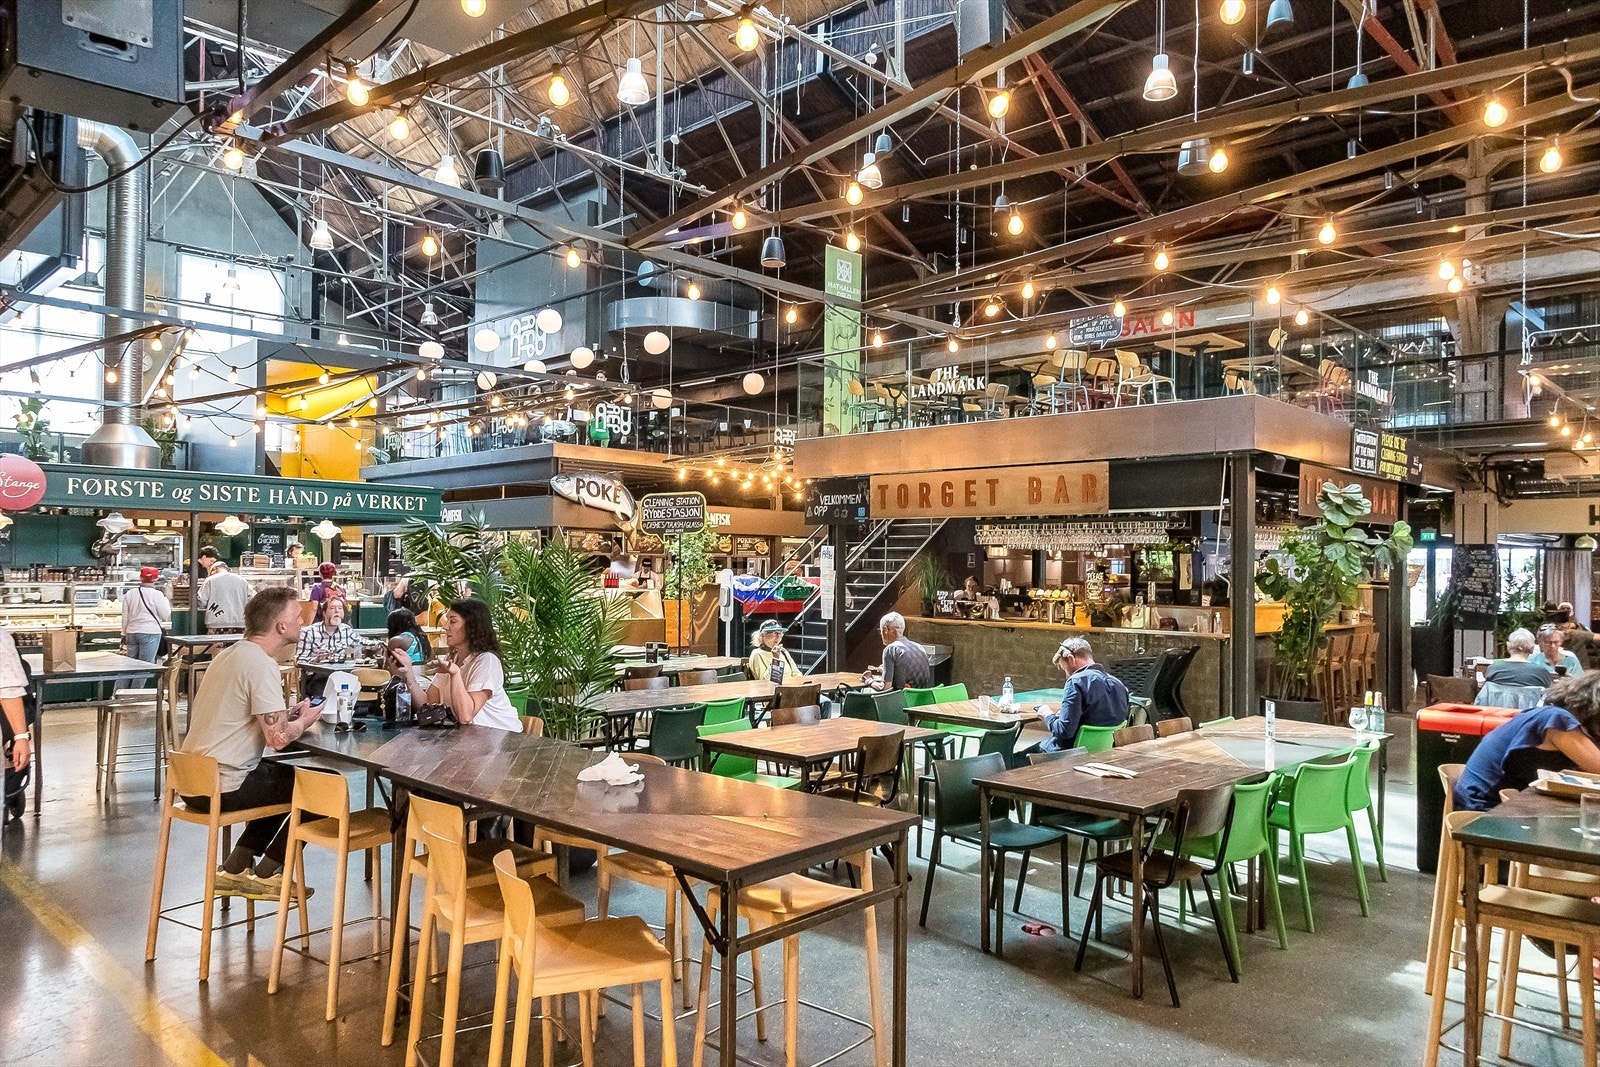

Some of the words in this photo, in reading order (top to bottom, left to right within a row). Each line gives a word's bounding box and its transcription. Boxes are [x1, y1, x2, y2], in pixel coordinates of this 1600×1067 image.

[936, 365, 960, 381] THE
[1367, 369, 1379, 385] THE
[911, 376, 986, 398] LANDMARK
[1357, 380, 1389, 404] LANDMARK
[67, 477, 165, 498] FØRSTE
[171, 486, 193, 503] og
[199, 484, 261, 503] SISTE
[269, 485, 329, 506] HÅND
[332, 492, 352, 510] på
[356, 493, 428, 512] VERKET
[575, 477, 622, 505] POKE
[877, 478, 1000, 510] TORGET
[1028, 473, 1099, 504] BAR
[643, 497, 675, 508] CLEANING
[675, 496, 701, 505] STATION
[819, 493, 862, 506] VELKOMMEN
[1372, 486, 1397, 516] BAR
[643, 507, 700, 520] RYDDESTASJON
[813, 505, 828, 517] OPP
[208, 602, 225, 618] ME
